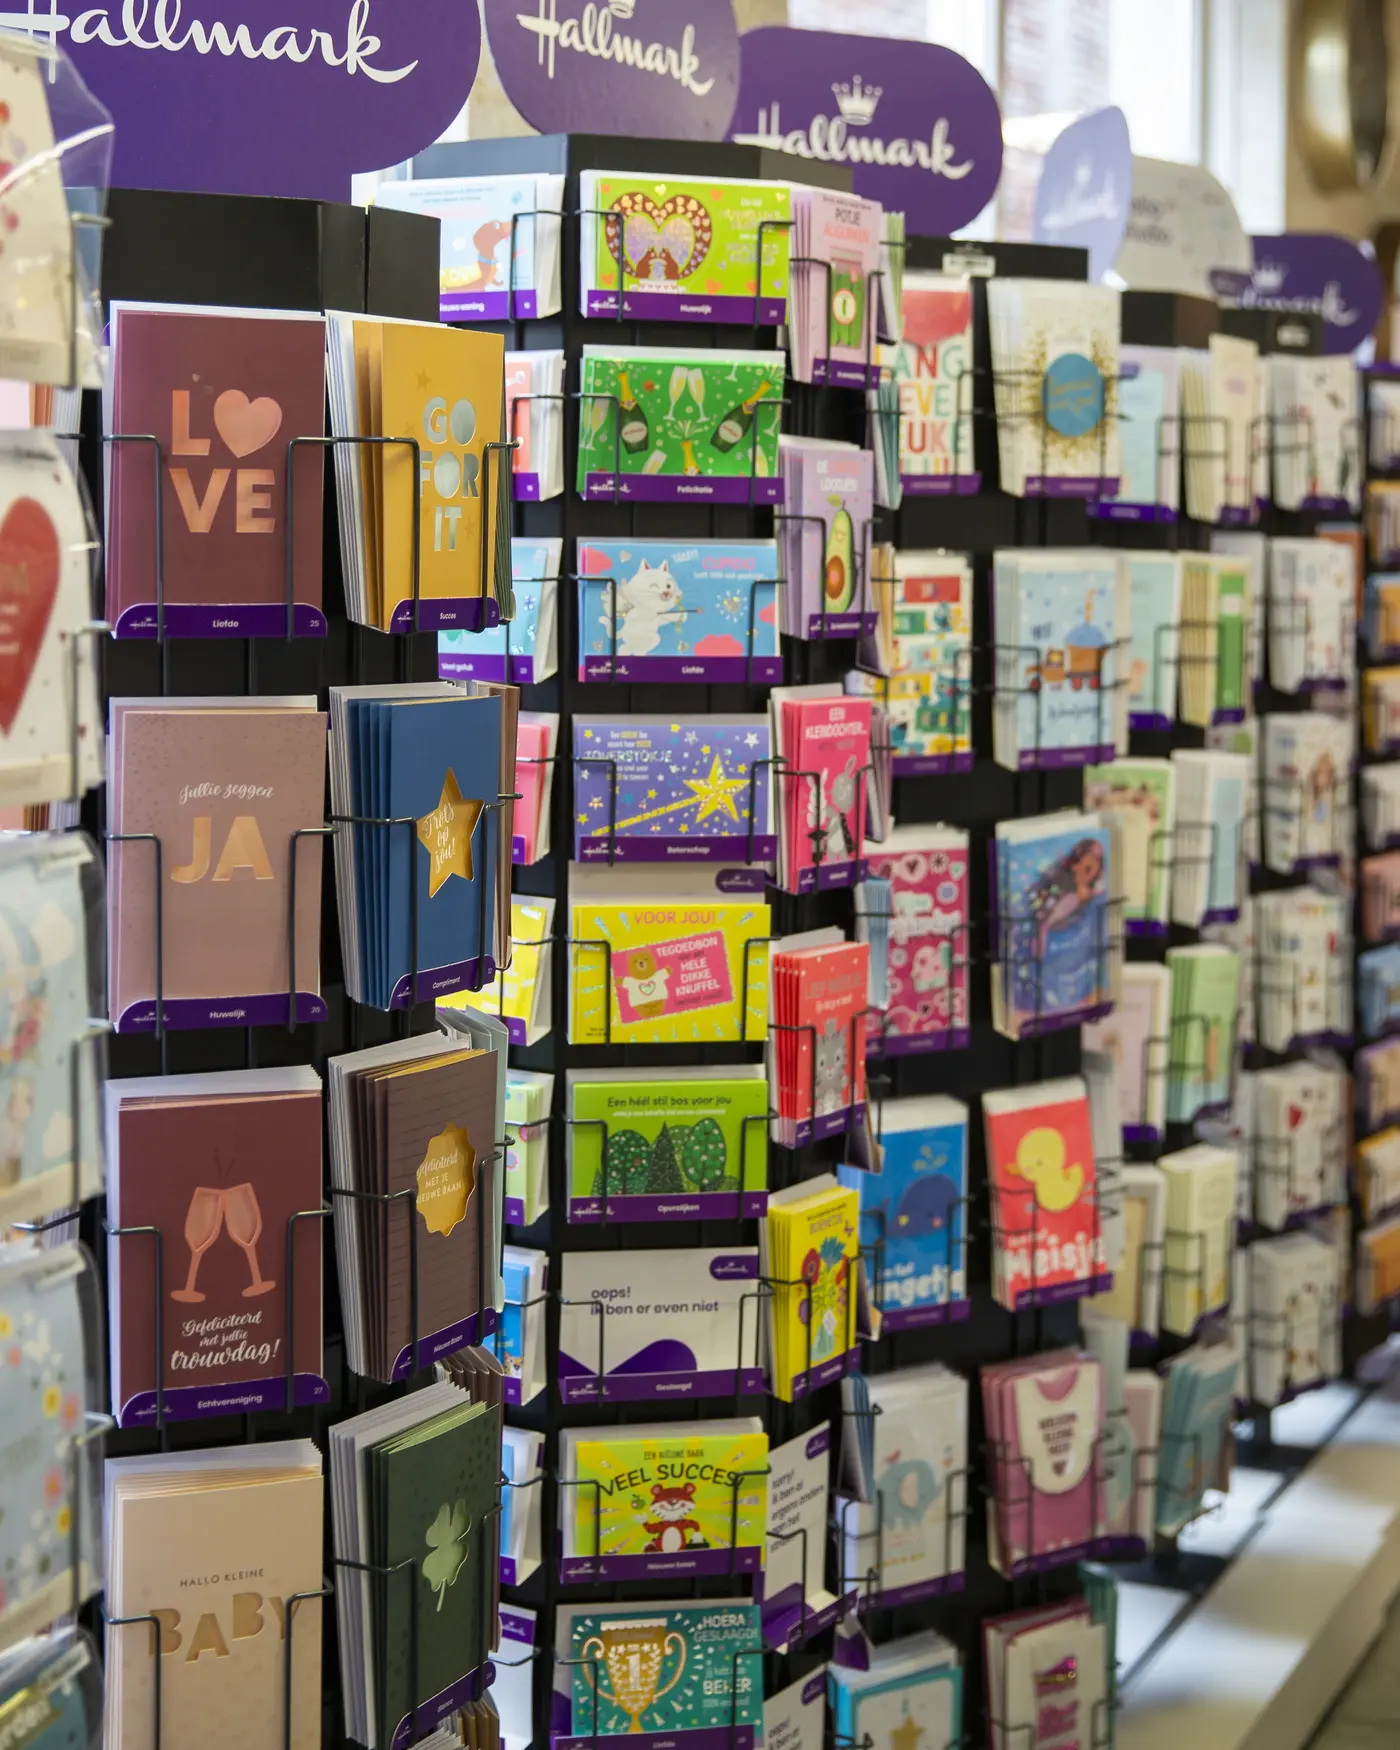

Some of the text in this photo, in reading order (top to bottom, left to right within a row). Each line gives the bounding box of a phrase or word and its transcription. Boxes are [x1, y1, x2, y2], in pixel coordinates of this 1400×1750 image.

[517, 0, 714, 95] Hallmark
[423, 397, 476, 447] GO
[419, 452, 481, 499] FOR
[434, 505, 463, 551] IT
[212, 619, 239, 629] Liefde
[439, 612, 457, 620] Succes
[179, 781, 275, 806] Jullie zeggen
[170, 816, 276, 884] JA
[633, 911, 677, 926] VOOR
[432, 976, 461, 990] Compliment
[209, 1009, 246, 1020] Huwelijk
[607, 1097, 626, 1108] Een
[653, 1094, 668, 1106] stil
[671, 1095, 688, 1106] bos
[691, 1097, 713, 1107] voor
[715, 1094, 732, 1107] jou
[425, 1172, 449, 1188] MET JE
[441, 1180, 462, 1196] BAAN
[590, 1286, 631, 1302] oops!
[605, 1303, 628, 1316] ben
[635, 1305, 651, 1315] er
[653, 1304, 689, 1315] even
[691, 1301, 719, 1313] niet
[181, 1309, 263, 1338] Gefeliciteerd
[170, 1338, 281, 1372] trouwdag!
[197, 1394, 263, 1410] Echtvereniging
[600, 1467, 653, 1497] VEEL
[179, 1568, 265, 1589] HALLO KLEINE
[147, 1592, 303, 1665] BABY
[702, 1613, 745, 1628] HOERA
